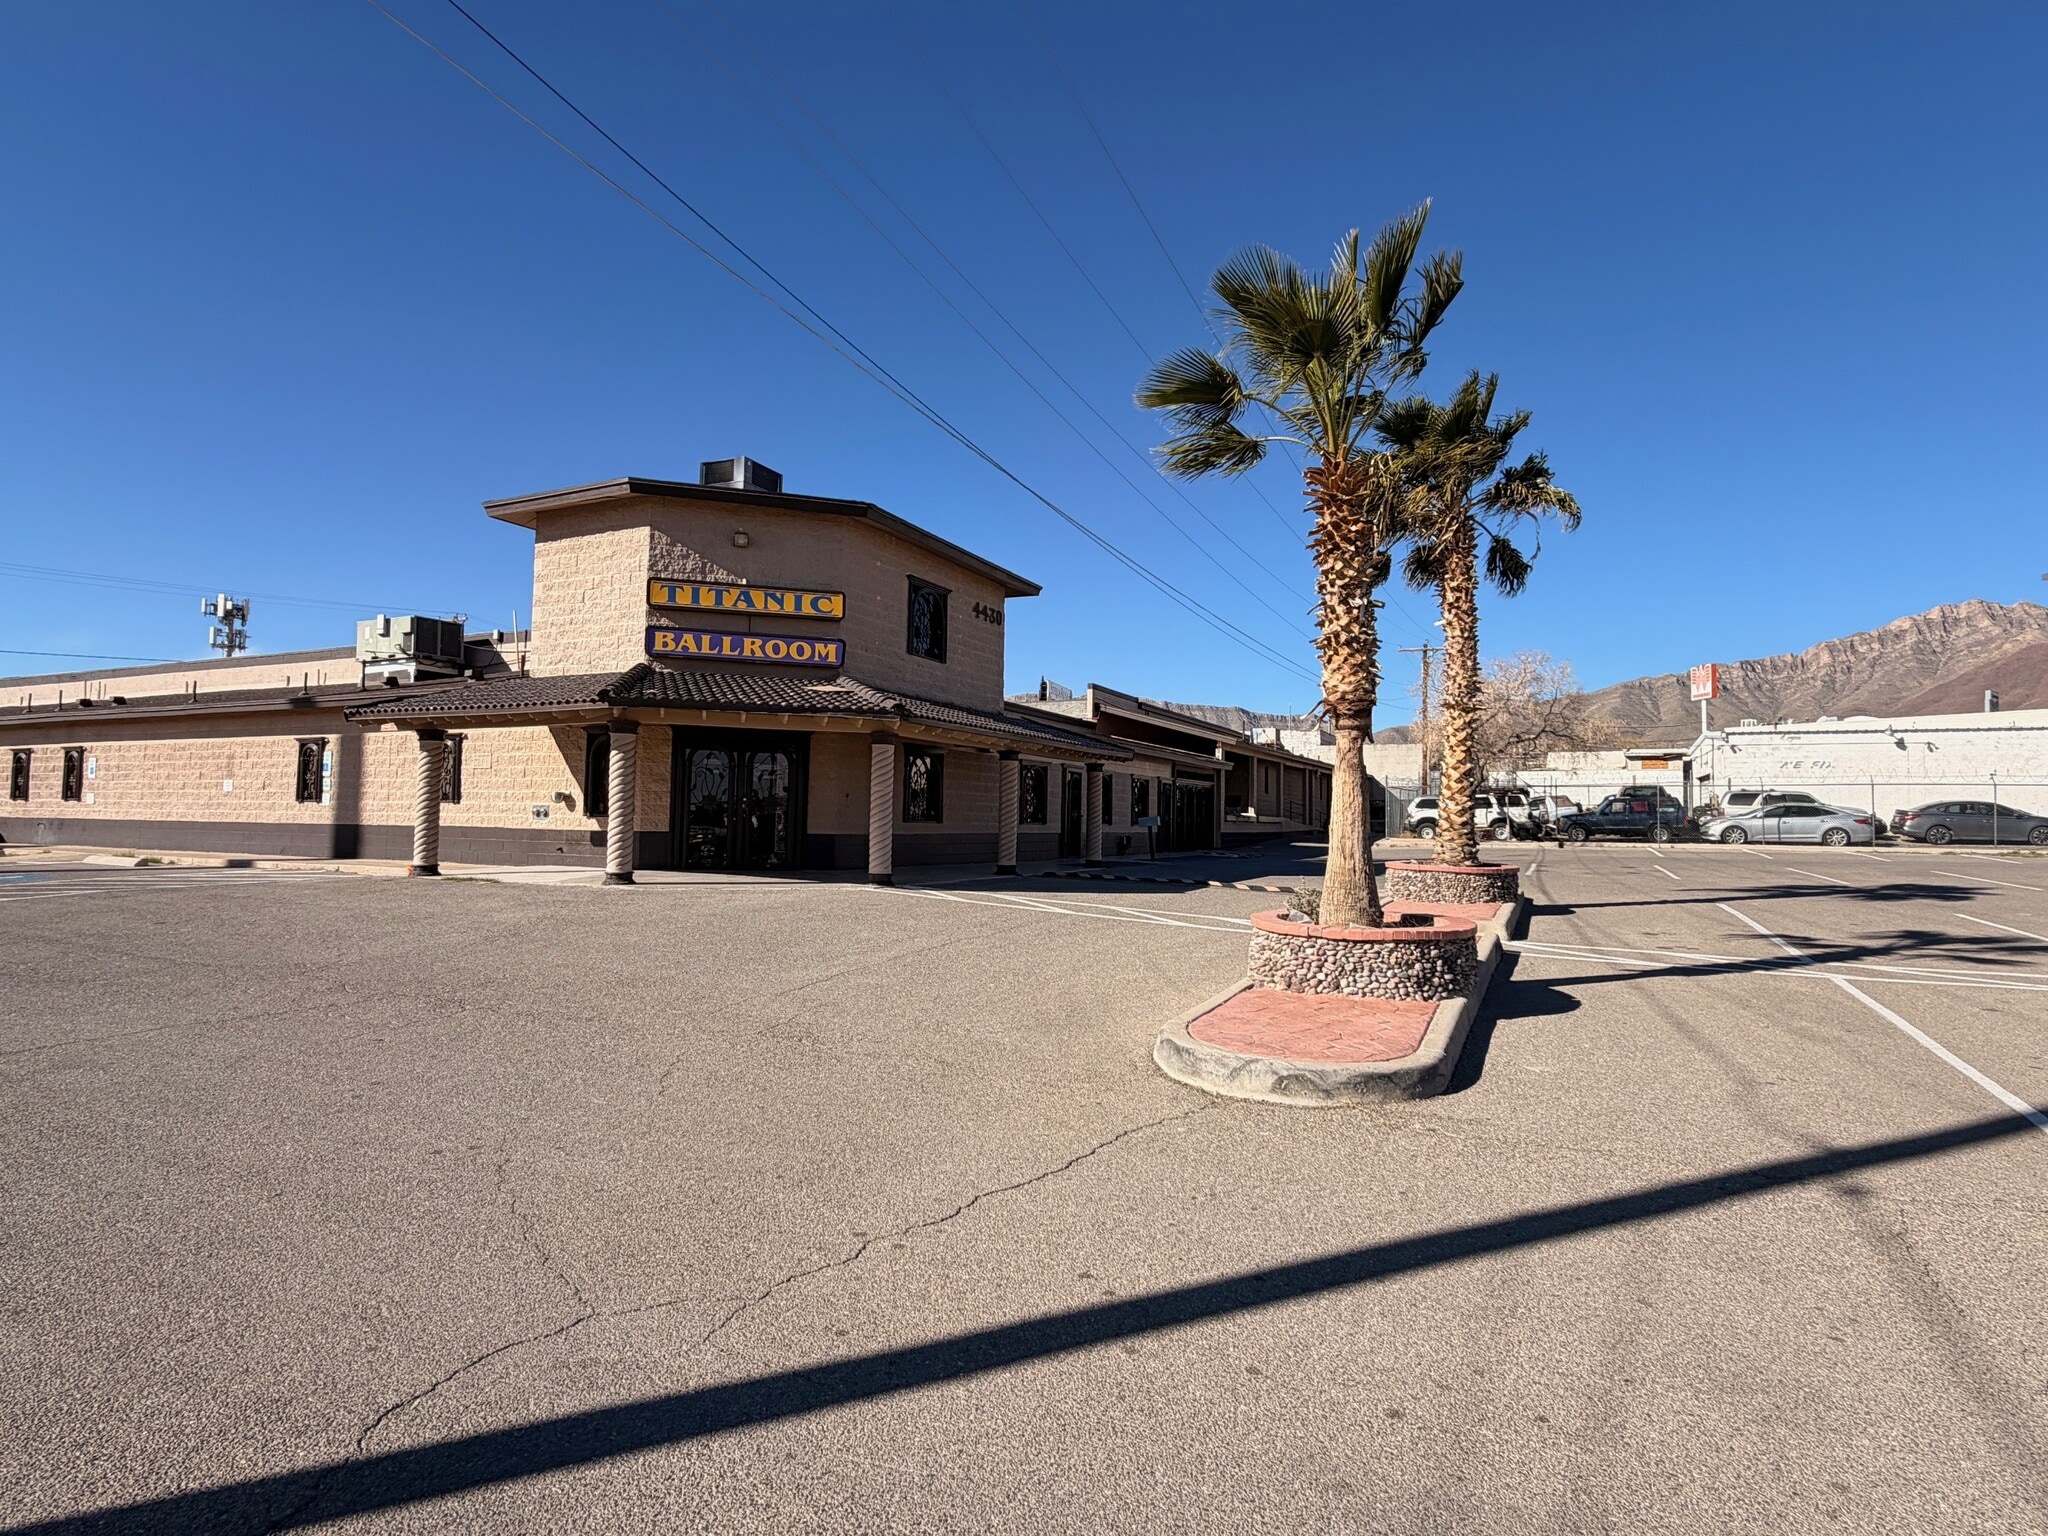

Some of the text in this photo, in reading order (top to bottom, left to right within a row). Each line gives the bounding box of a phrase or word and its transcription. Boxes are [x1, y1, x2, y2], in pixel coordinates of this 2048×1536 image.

[660, 584, 834, 614] TITANIC
[972, 602, 1002, 626] 4430
[653, 631, 838, 662] BALLROOM
